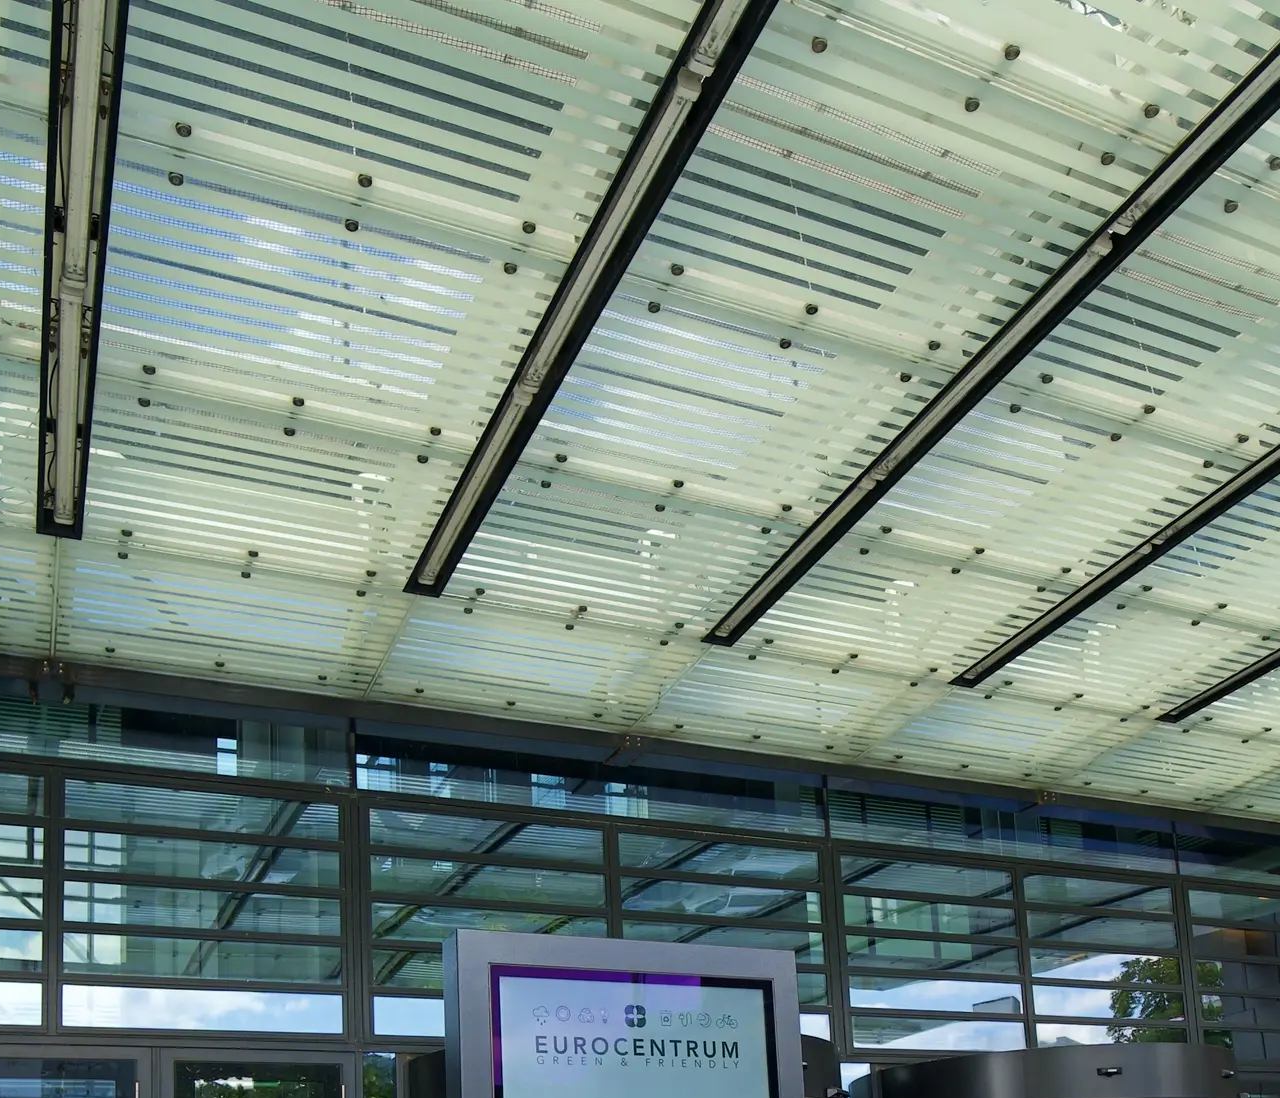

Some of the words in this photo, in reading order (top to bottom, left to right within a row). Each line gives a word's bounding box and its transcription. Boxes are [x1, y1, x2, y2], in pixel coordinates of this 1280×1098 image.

[535, 1035, 740, 1059] EUROCENTRUM
[536, 1056, 603, 1067] GREEN
[620, 1057, 628, 1067] &
[645, 1058, 740, 1069] FRIENDLY
